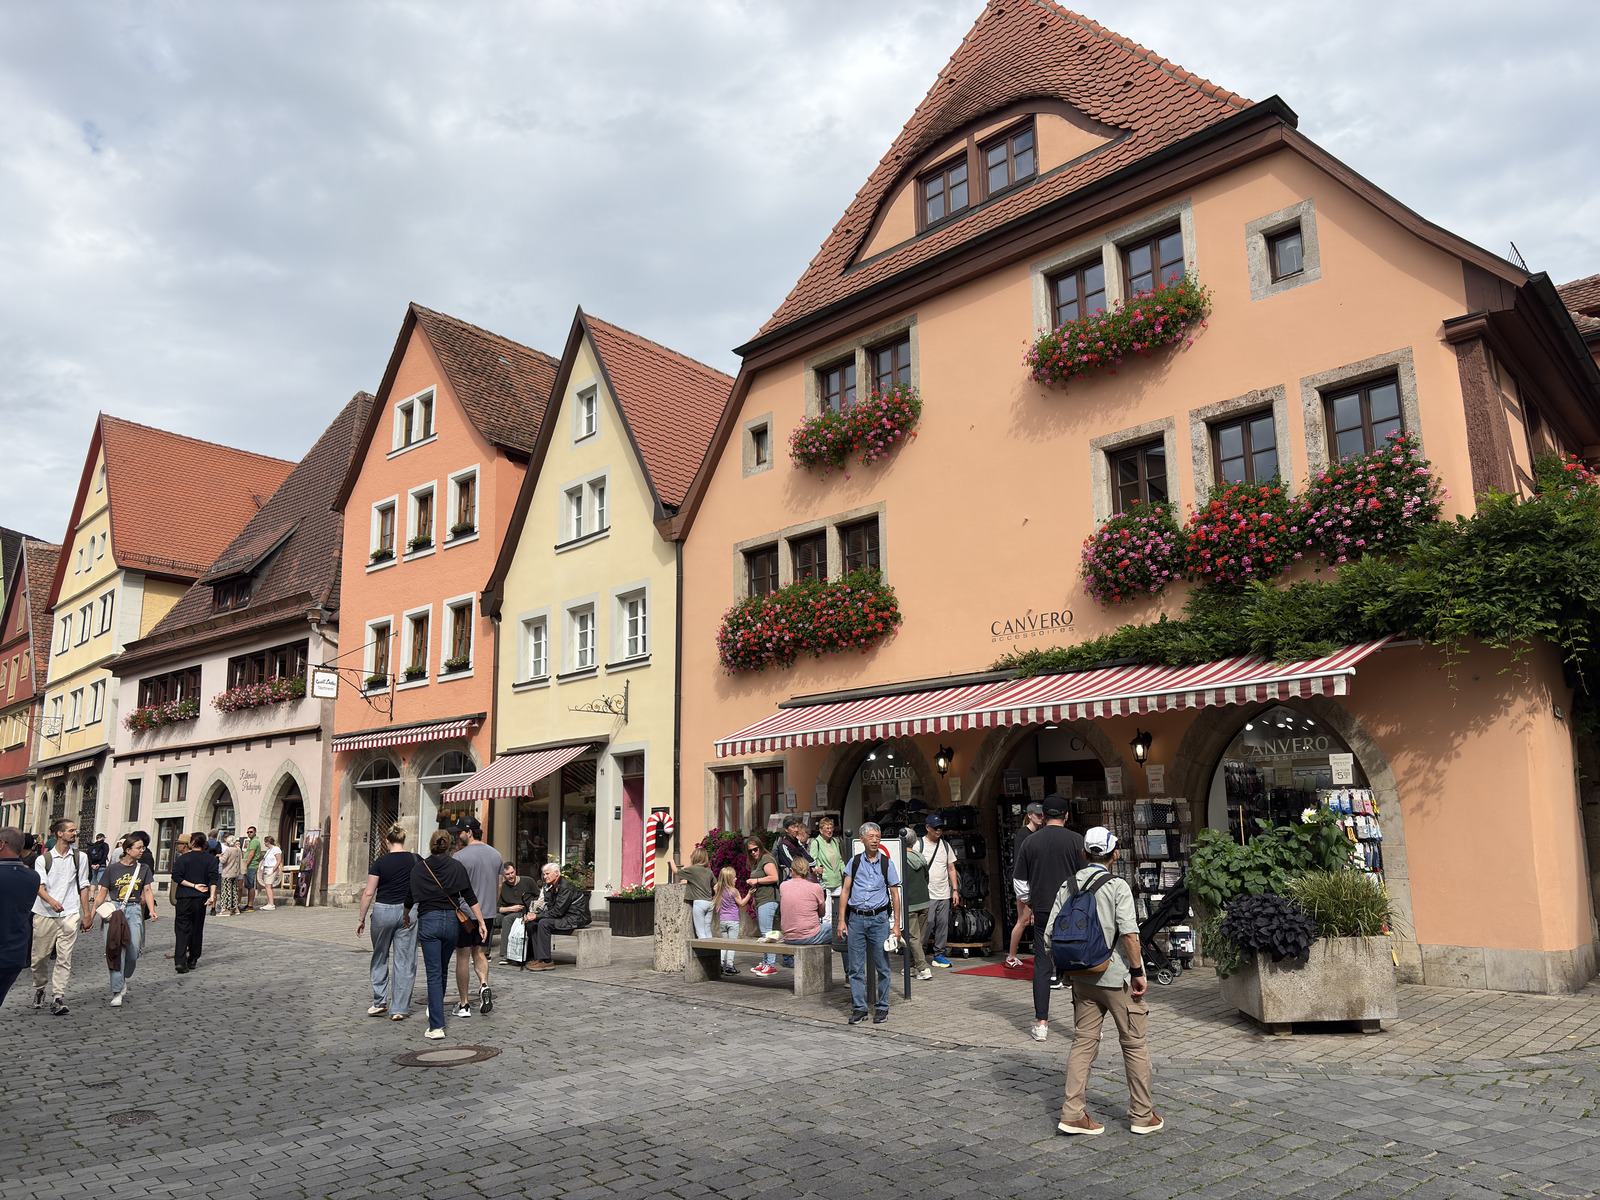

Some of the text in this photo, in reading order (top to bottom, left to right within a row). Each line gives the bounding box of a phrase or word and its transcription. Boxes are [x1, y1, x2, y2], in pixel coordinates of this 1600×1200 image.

[991, 610, 1073, 635] CANVERO
[991, 627, 1074, 642] accessoires
[1240, 736, 1329, 757] CANVERO
[861, 767, 915, 781] CANVERO
